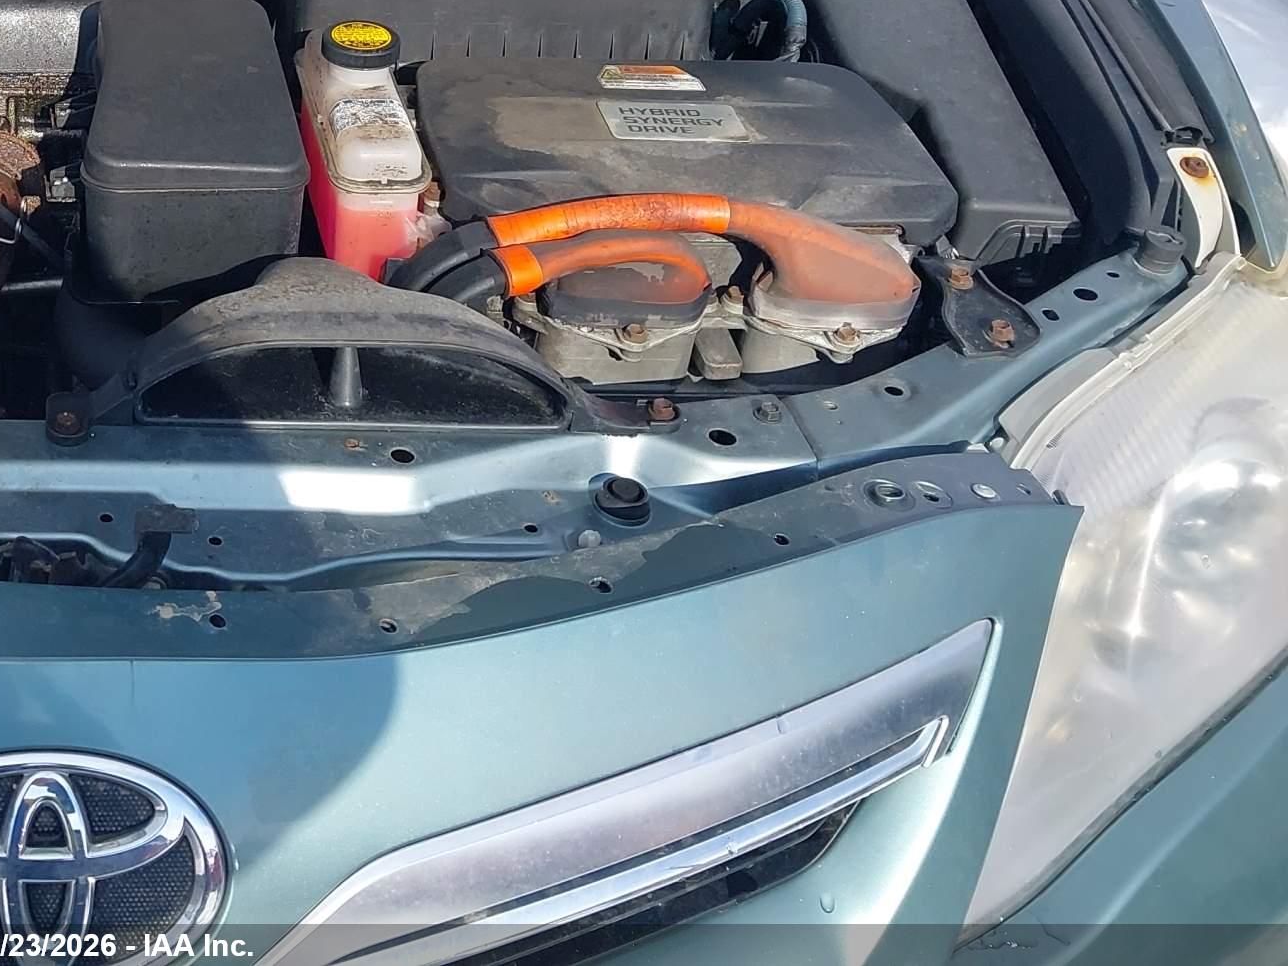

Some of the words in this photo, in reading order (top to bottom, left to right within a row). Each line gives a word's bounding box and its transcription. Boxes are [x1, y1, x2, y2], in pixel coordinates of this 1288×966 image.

[618, 106, 701, 117] HYBRID
[623, 116, 725, 127] SYNERGY
[628, 125, 694, 135] DRIVE
